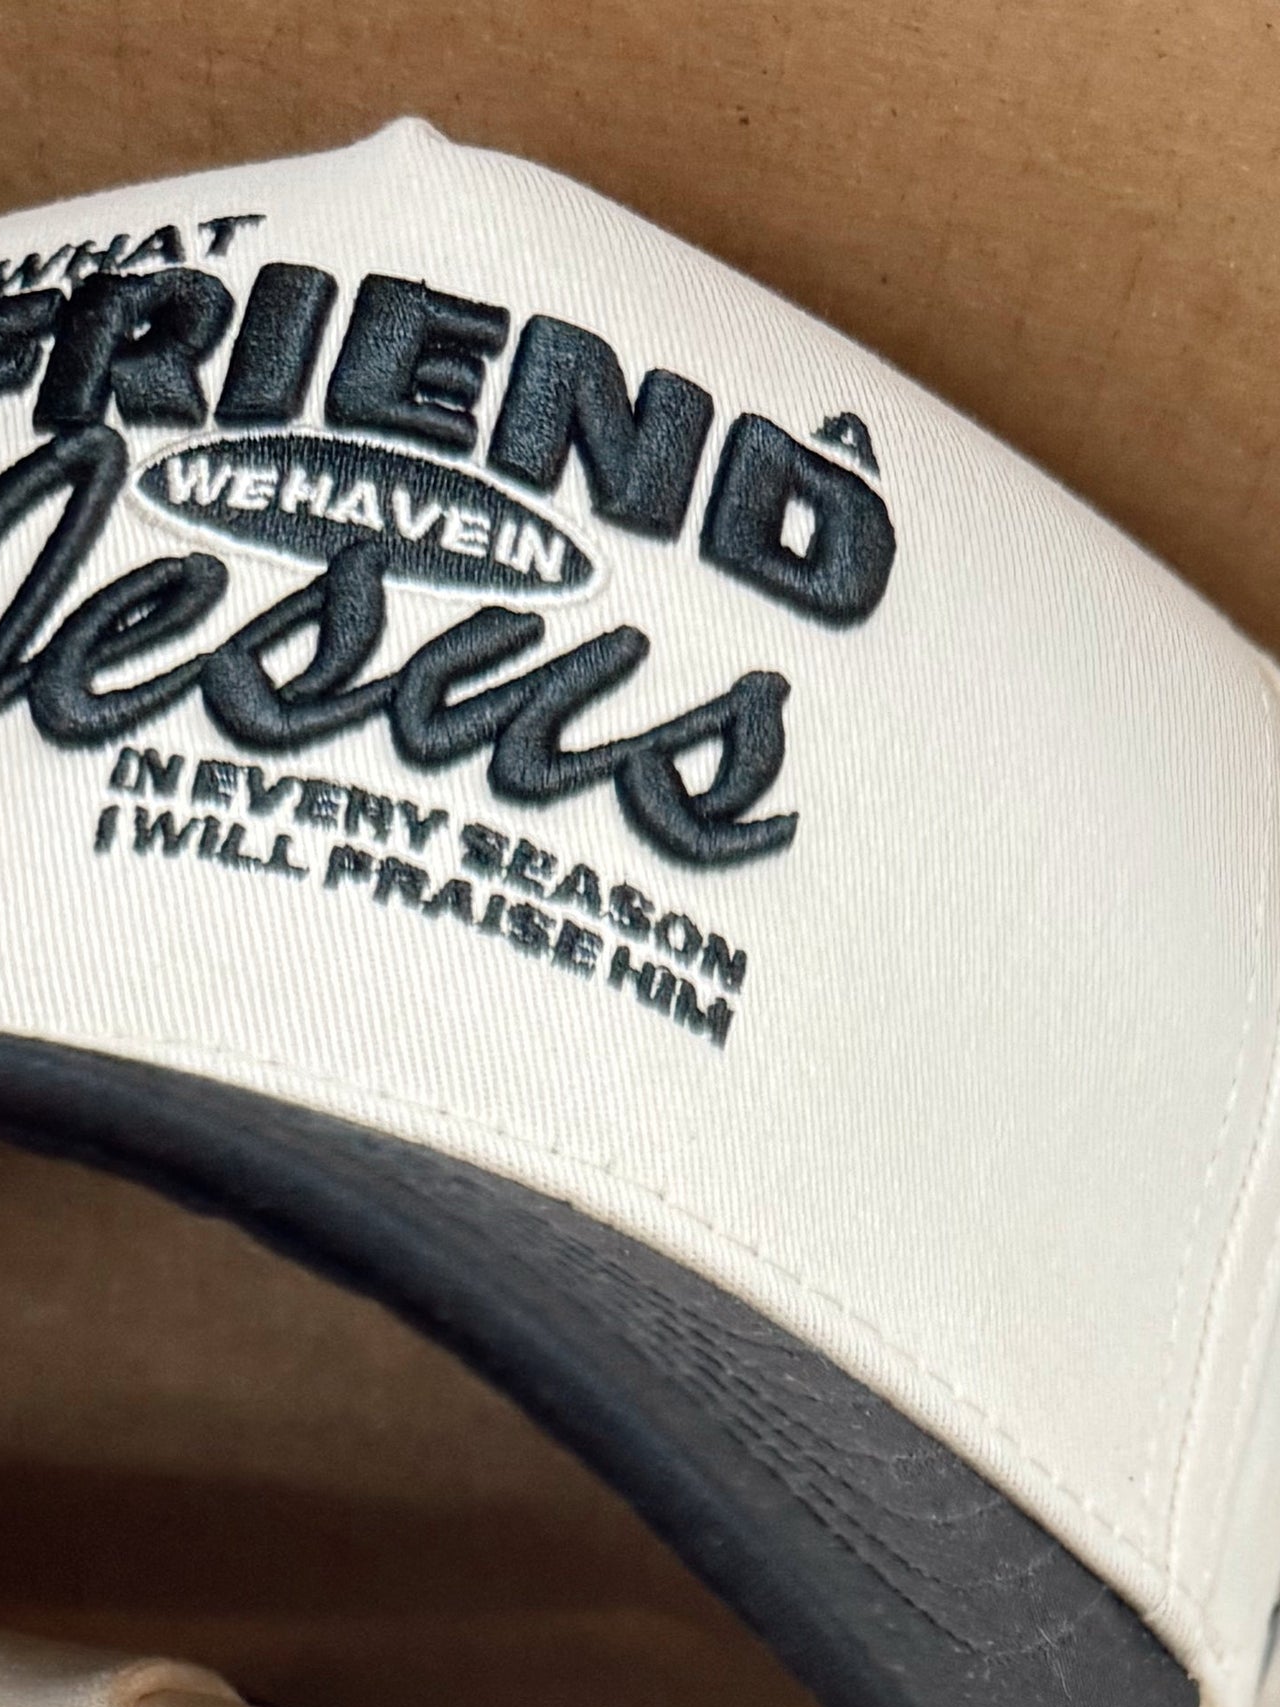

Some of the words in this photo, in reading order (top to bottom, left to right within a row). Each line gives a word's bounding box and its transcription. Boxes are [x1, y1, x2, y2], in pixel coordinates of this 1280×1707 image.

[94, 805, 120, 854] I
[133, 806, 310, 880] WILL
[191, 758, 450, 852] EVERY
[460, 820, 748, 997] SEASON
